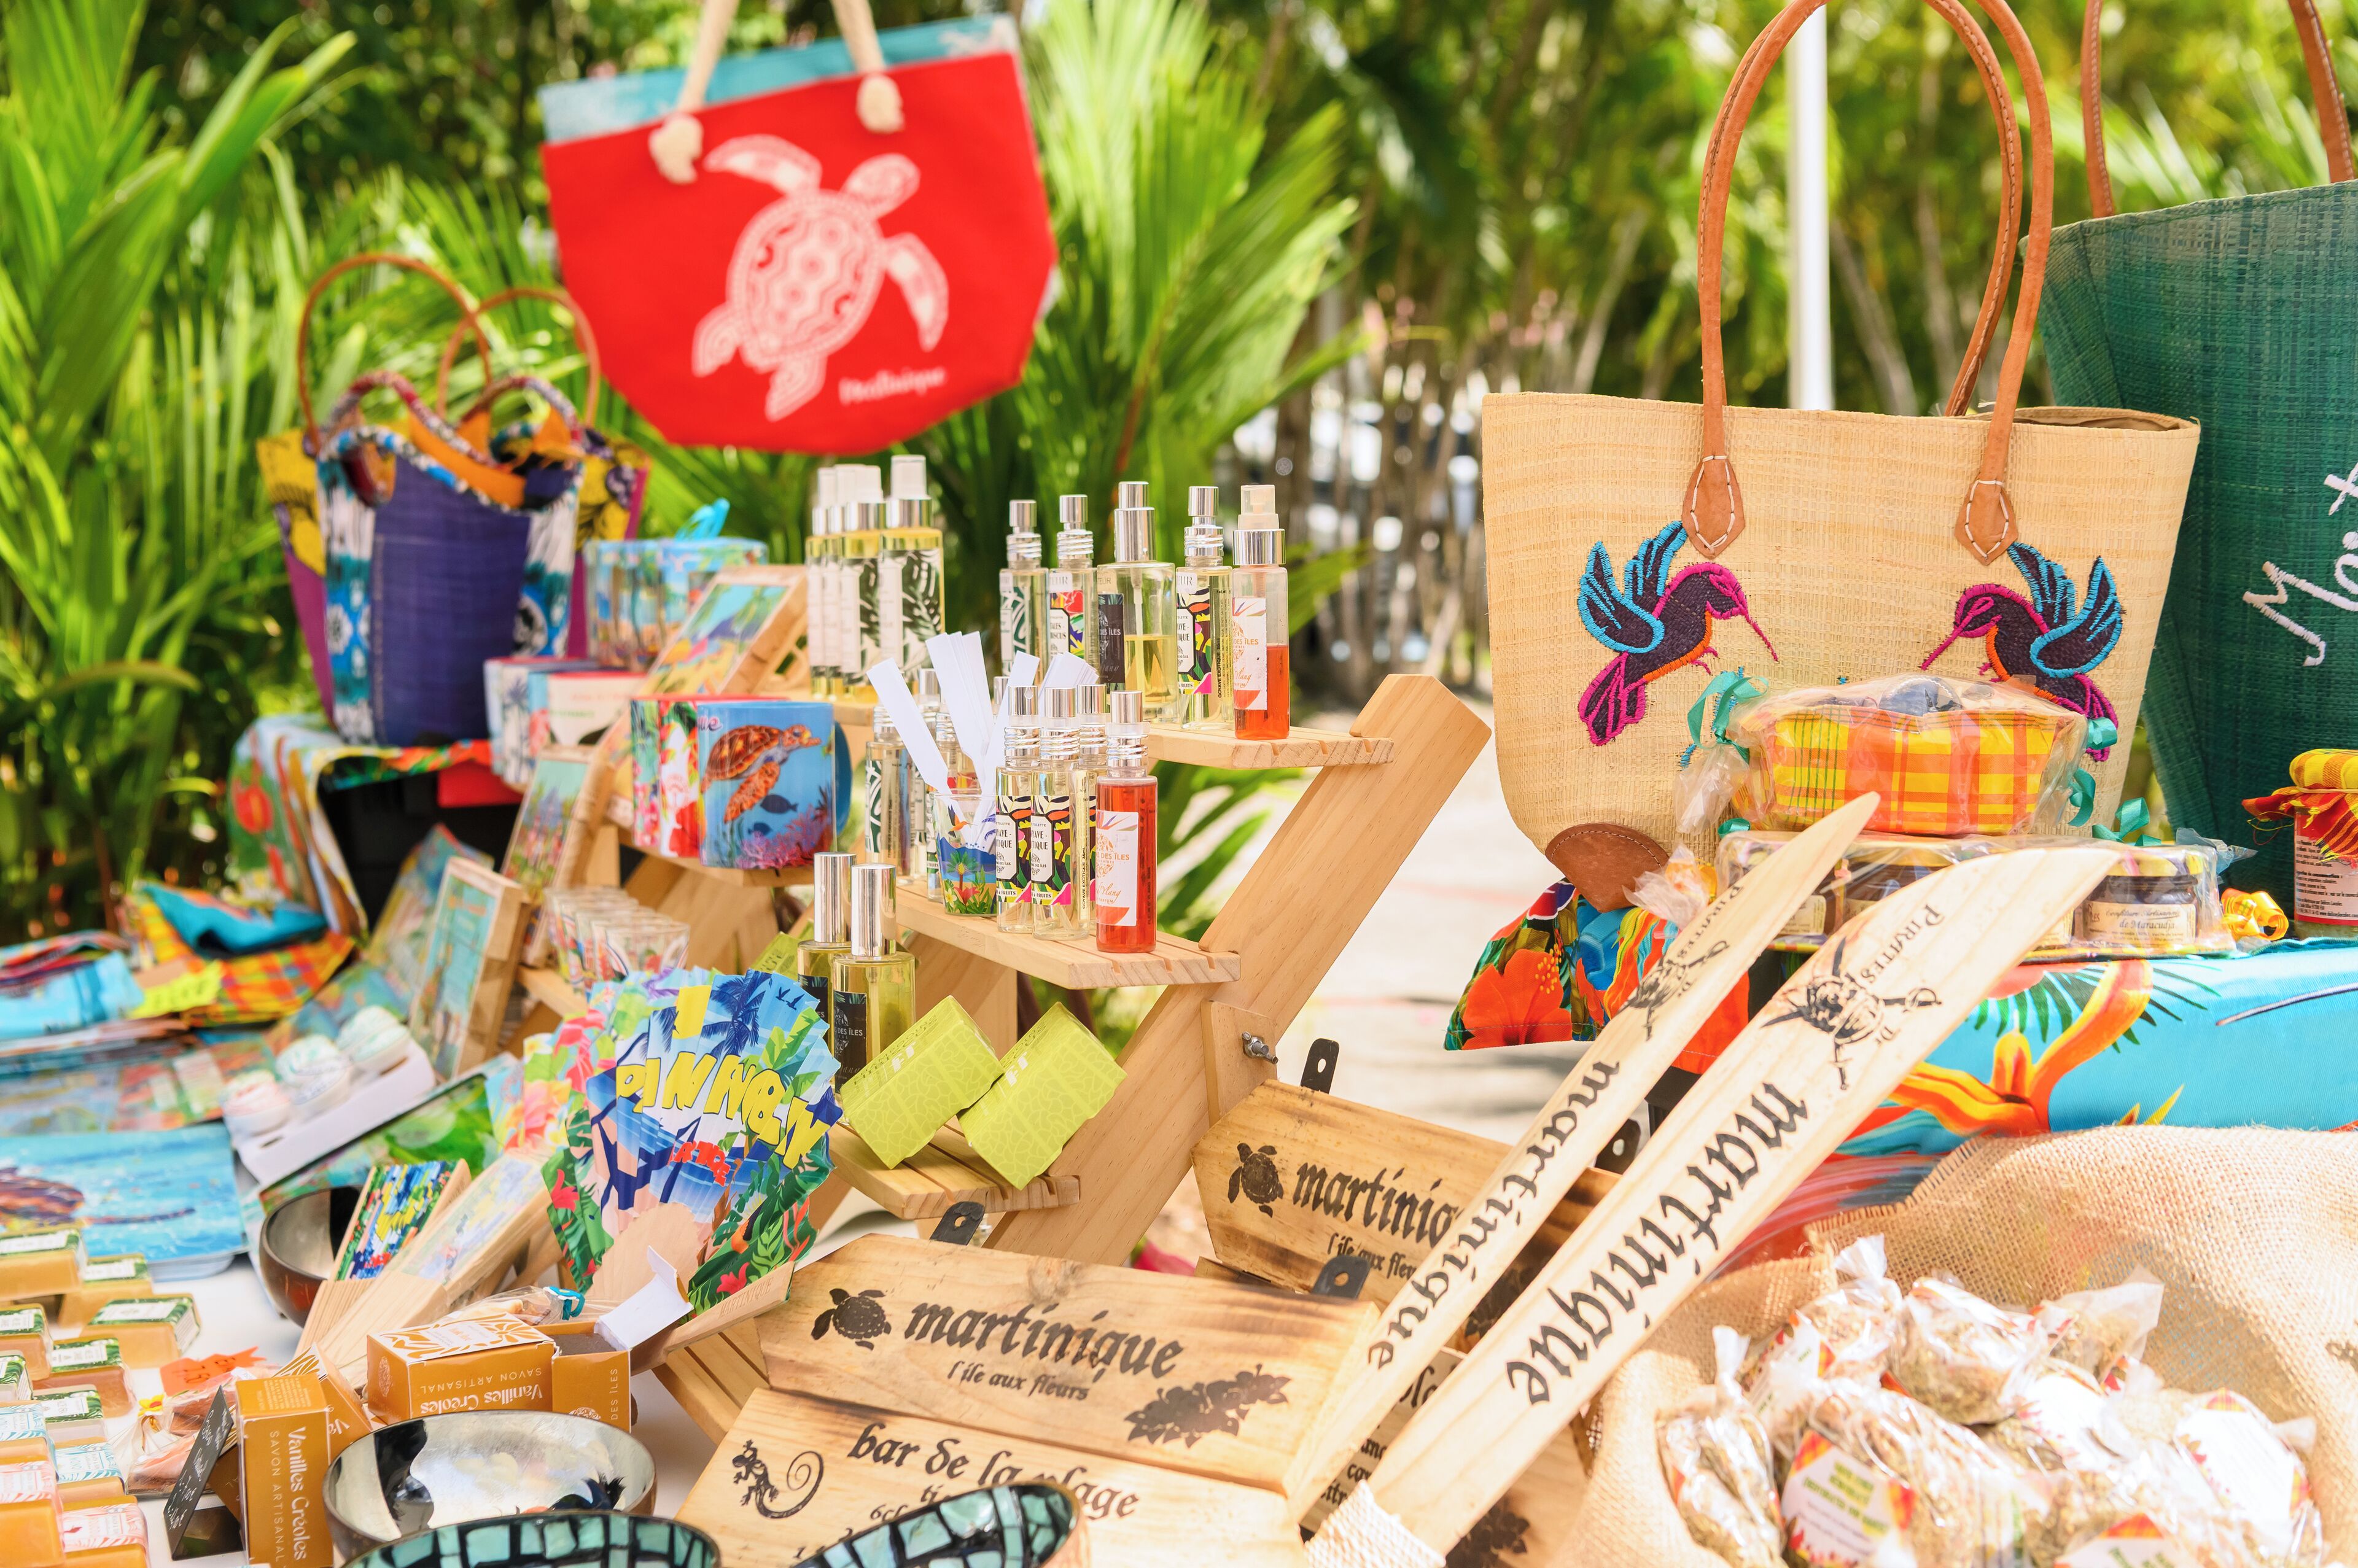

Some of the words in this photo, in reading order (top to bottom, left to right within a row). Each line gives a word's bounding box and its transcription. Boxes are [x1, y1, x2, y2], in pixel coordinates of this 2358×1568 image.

[1115, 852, 1130, 861] ÎLES
[849, 1027, 863, 1036] ÎLES
[718, 1276, 773, 1318] MARTINIQUE
[419, 1376, 492, 1395] ARTISANAL
[499, 1367, 542, 1382] SAVON
[609, 1368, 619, 1394] ÎLES
[989, 1373, 1027, 1391] aux
[1027, 1374, 1090, 1400] fleurs
[419, 1394, 480, 1415] Créoles
[484, 1383, 544, 1406] Vanilles
[610, 1401, 619, 1421] DES
[269, 1430, 281, 1477] SAVON
[287, 1426, 307, 1492] Vanilles
[847, 1422, 920, 1467] bar
[924, 1438, 970, 1480] de
[271, 1485, 286, 1562] ARTISANAL
[290, 1497, 311, 1561] Créoles
